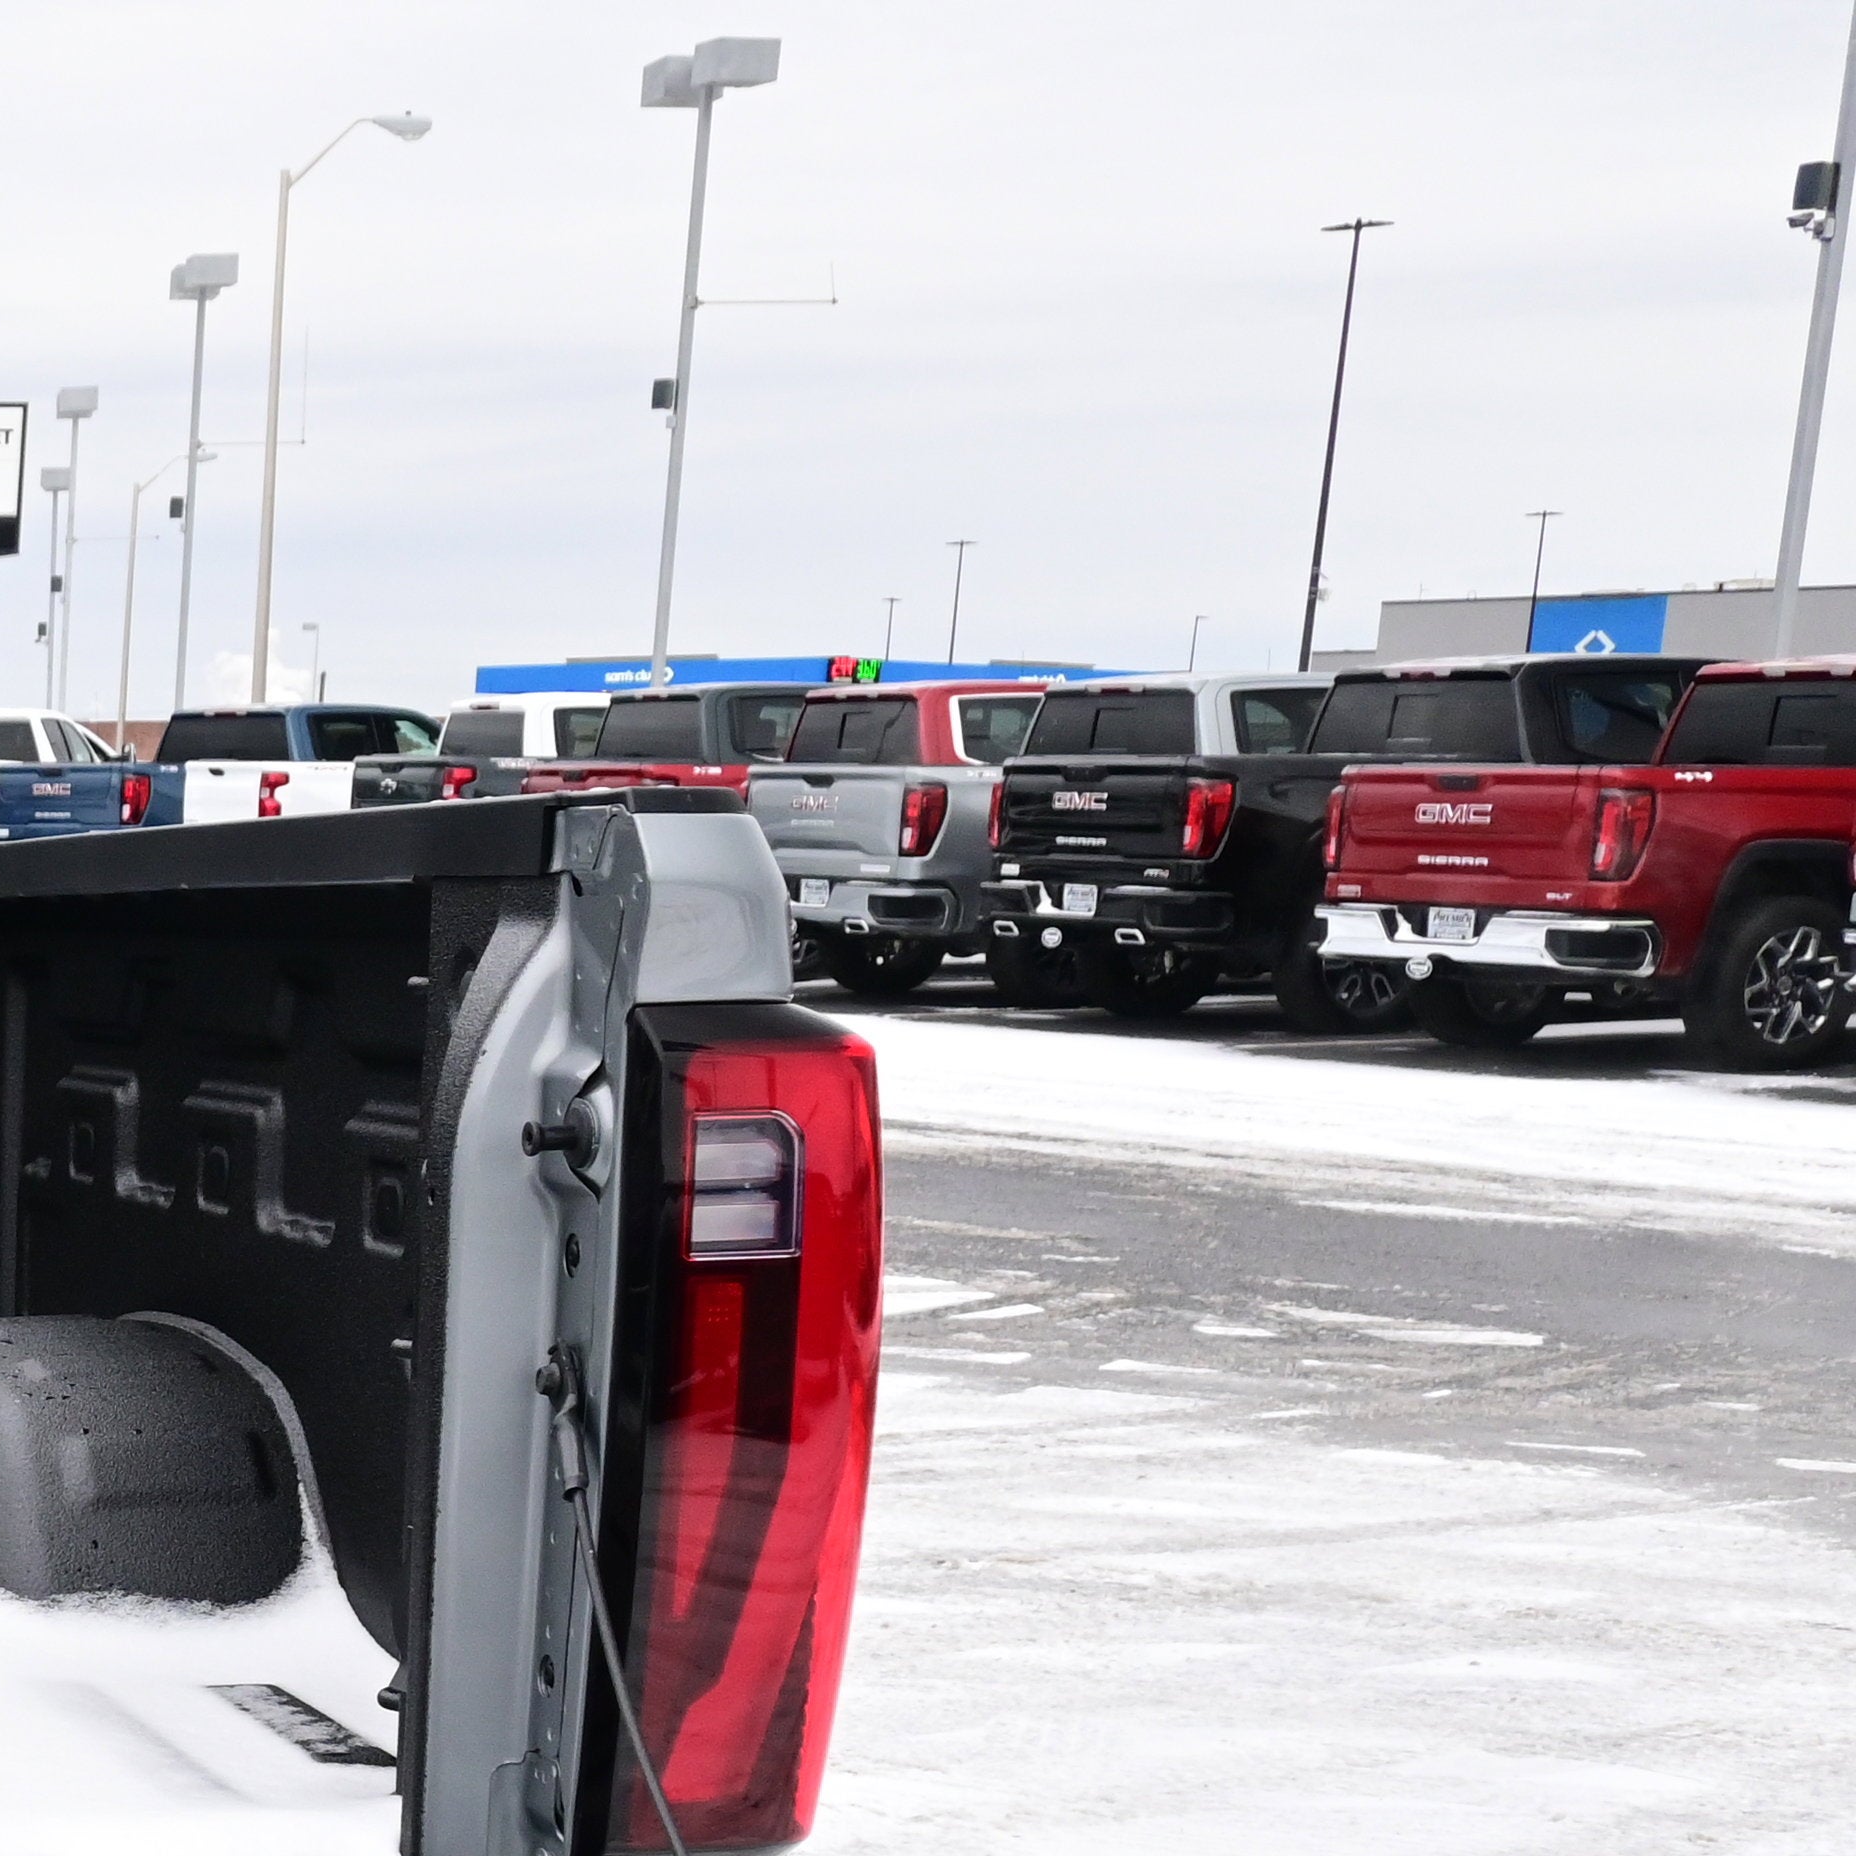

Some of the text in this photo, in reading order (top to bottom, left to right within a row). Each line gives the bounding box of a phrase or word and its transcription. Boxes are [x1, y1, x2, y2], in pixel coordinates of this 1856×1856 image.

[32, 783, 71, 796] GMC
[1052, 791, 1108, 811] GMC
[1415, 803, 1493, 825] GMC
[1417, 854, 1489, 867] SIERRA
